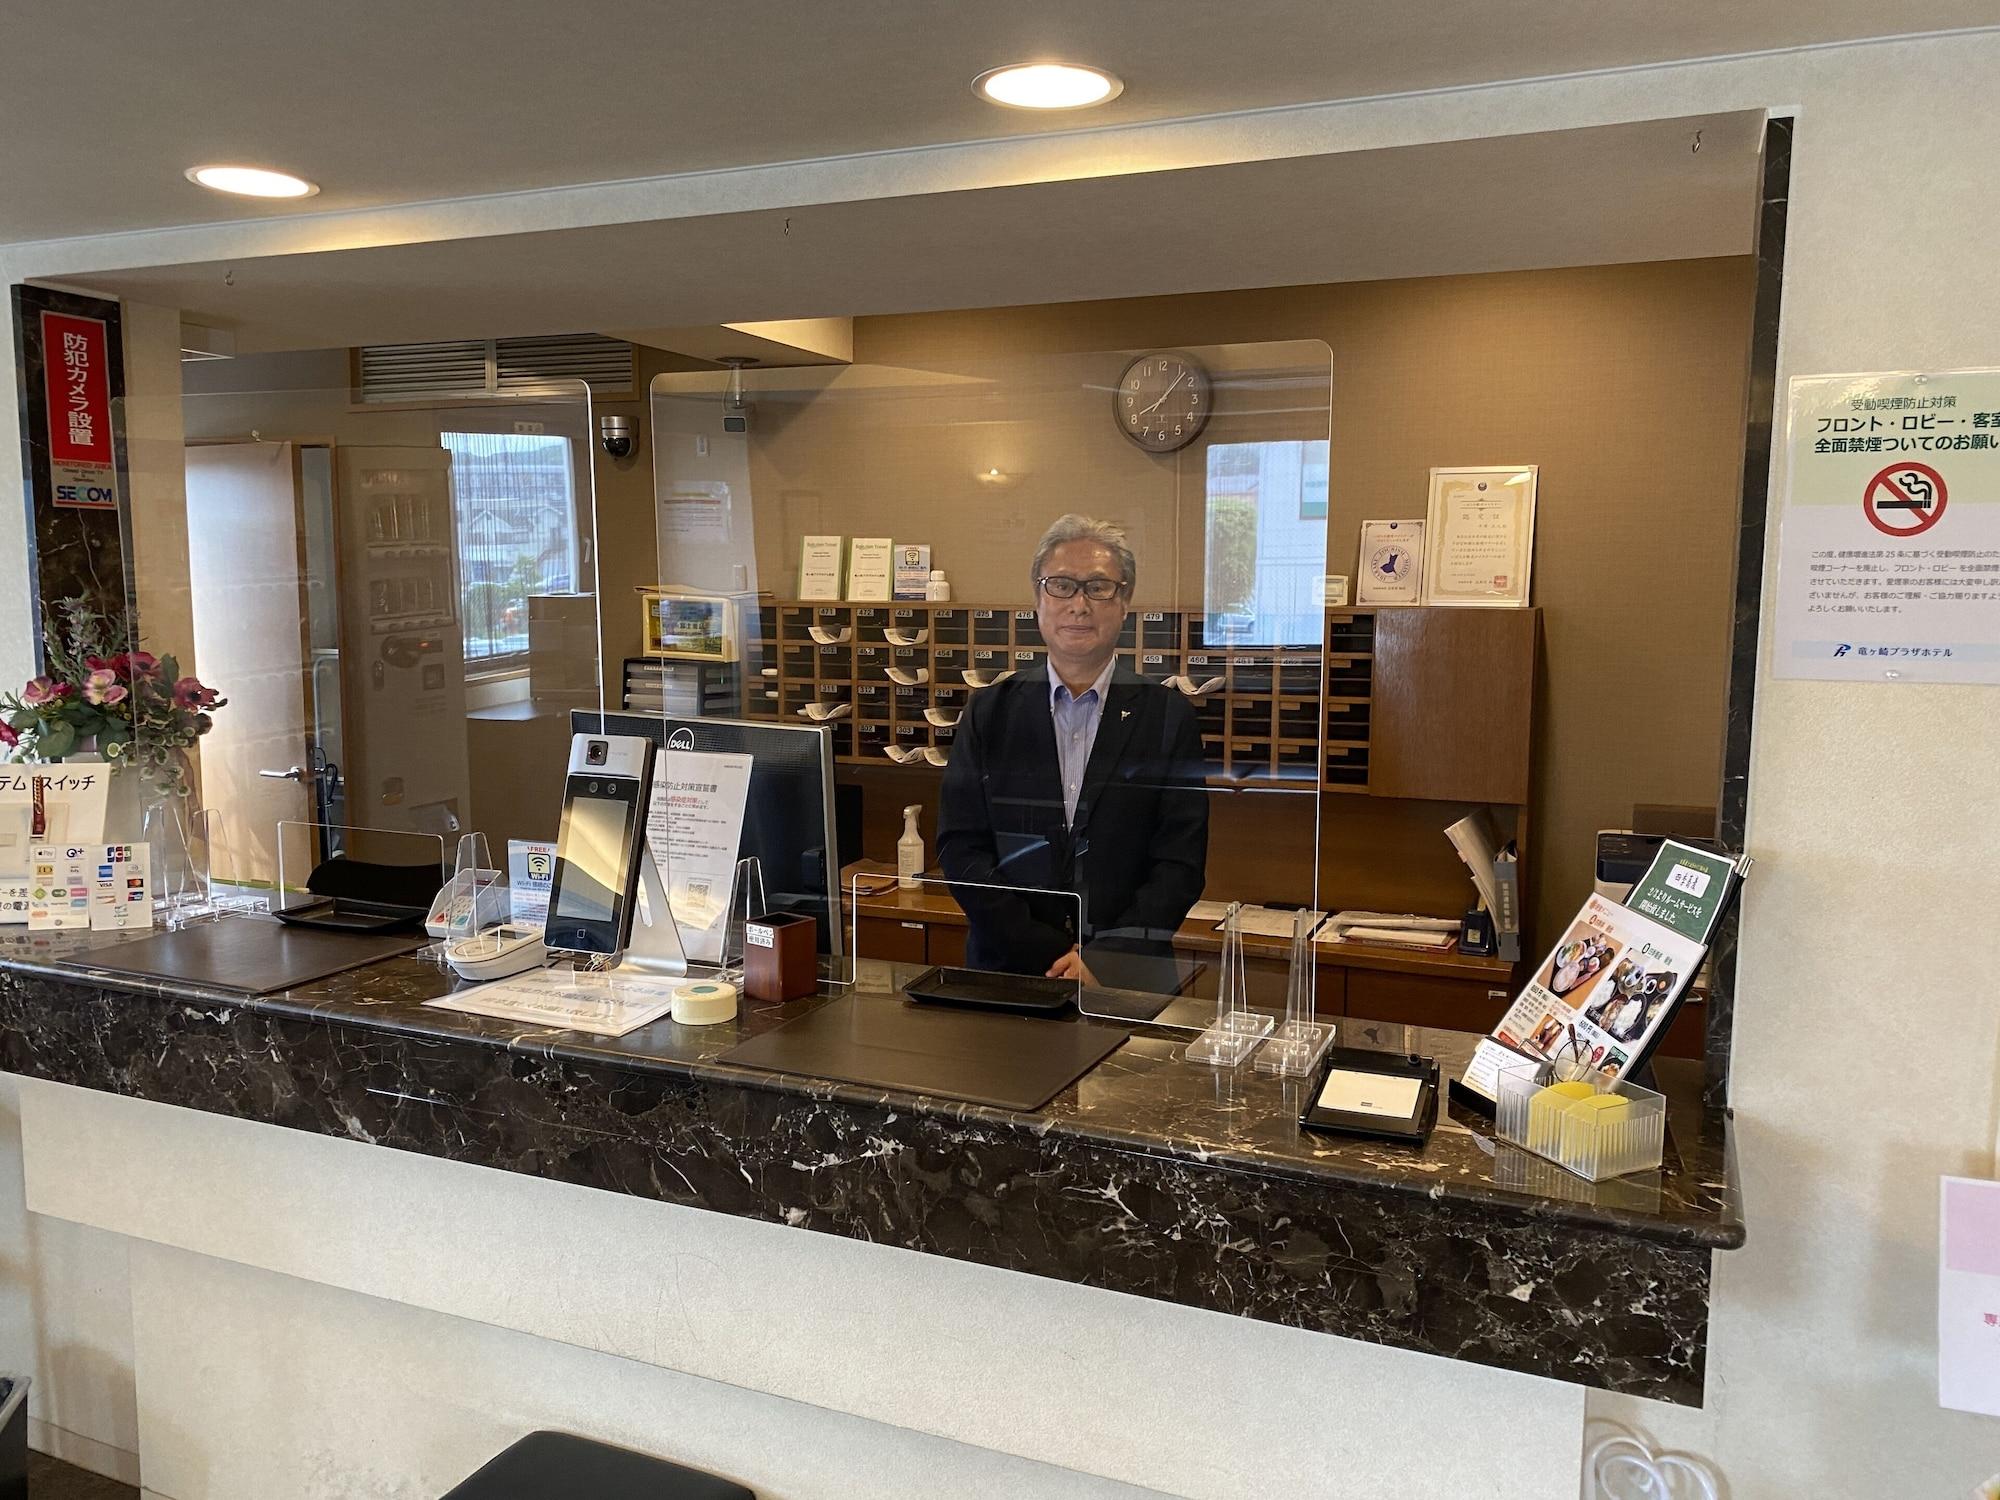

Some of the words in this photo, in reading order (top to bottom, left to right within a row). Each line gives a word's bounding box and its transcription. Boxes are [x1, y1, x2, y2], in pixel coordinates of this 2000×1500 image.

[1159, 360, 1168, 371] 12
[1143, 366, 1151, 377] 11
[1130, 380, 1140, 390] 10
[1187, 376, 1194, 387] 2
[63, 331, 94, 446] 防犯カメラ設置
[1126, 397, 1134, 407] 9
[1191, 393, 1199, 405] 3
[1851, 395, 1958, 411] 受動喫煙防止対策
[1130, 414, 1138, 425] 8
[1186, 411, 1194, 422] 4
[1142, 426, 1149, 437] 7
[1158, 430, 1166, 441] 6
[1174, 424, 1182, 436] 5
[57, 485, 112, 502] SECOM
[975, 610, 990, 618] 475
[670, 739, 691, 750] DELL
[748, 925, 774, 937] ボールペン
[748, 935, 772, 946] 使用済み
